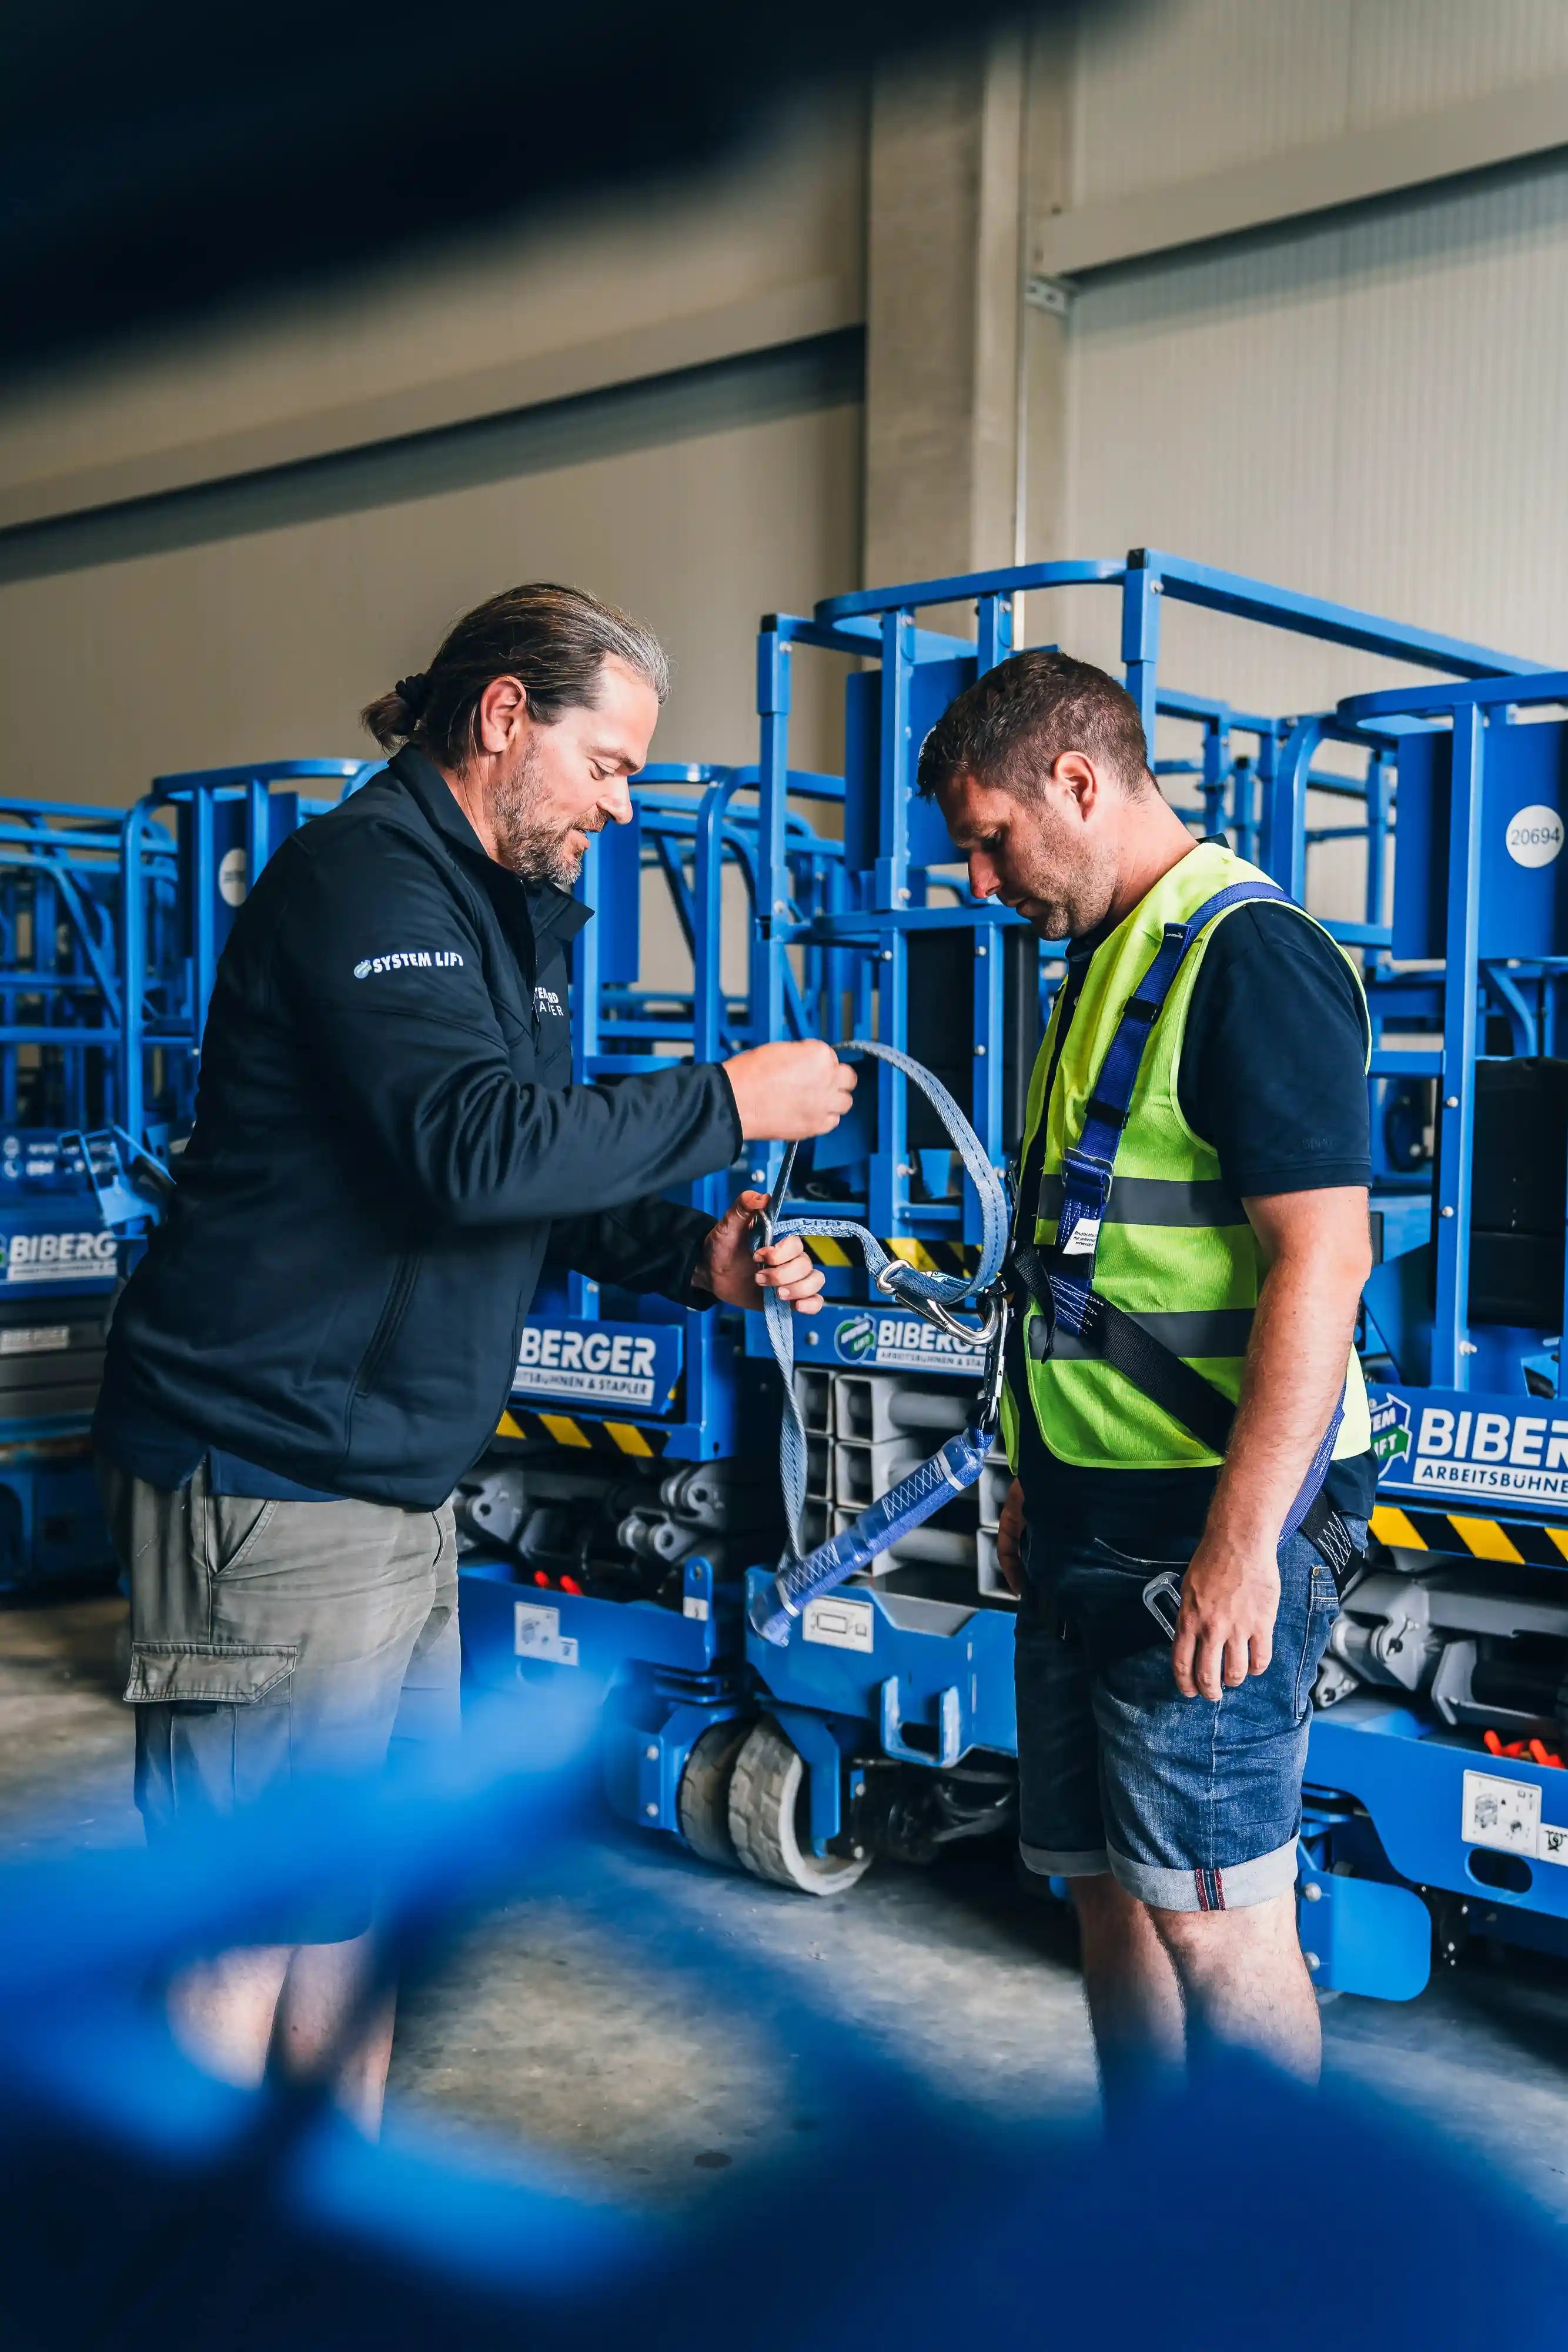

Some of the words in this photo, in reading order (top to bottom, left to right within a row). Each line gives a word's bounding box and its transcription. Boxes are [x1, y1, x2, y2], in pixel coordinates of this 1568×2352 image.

[1510, 827, 1560, 846] 20694
[372, 953, 432, 973] SYSTEM
[9, 1231, 118, 1263] BIBERG
[519, 1327, 656, 1378] BERGER
[588, 1377, 596, 1389] &
[599, 1378, 647, 1395] STAPLER
